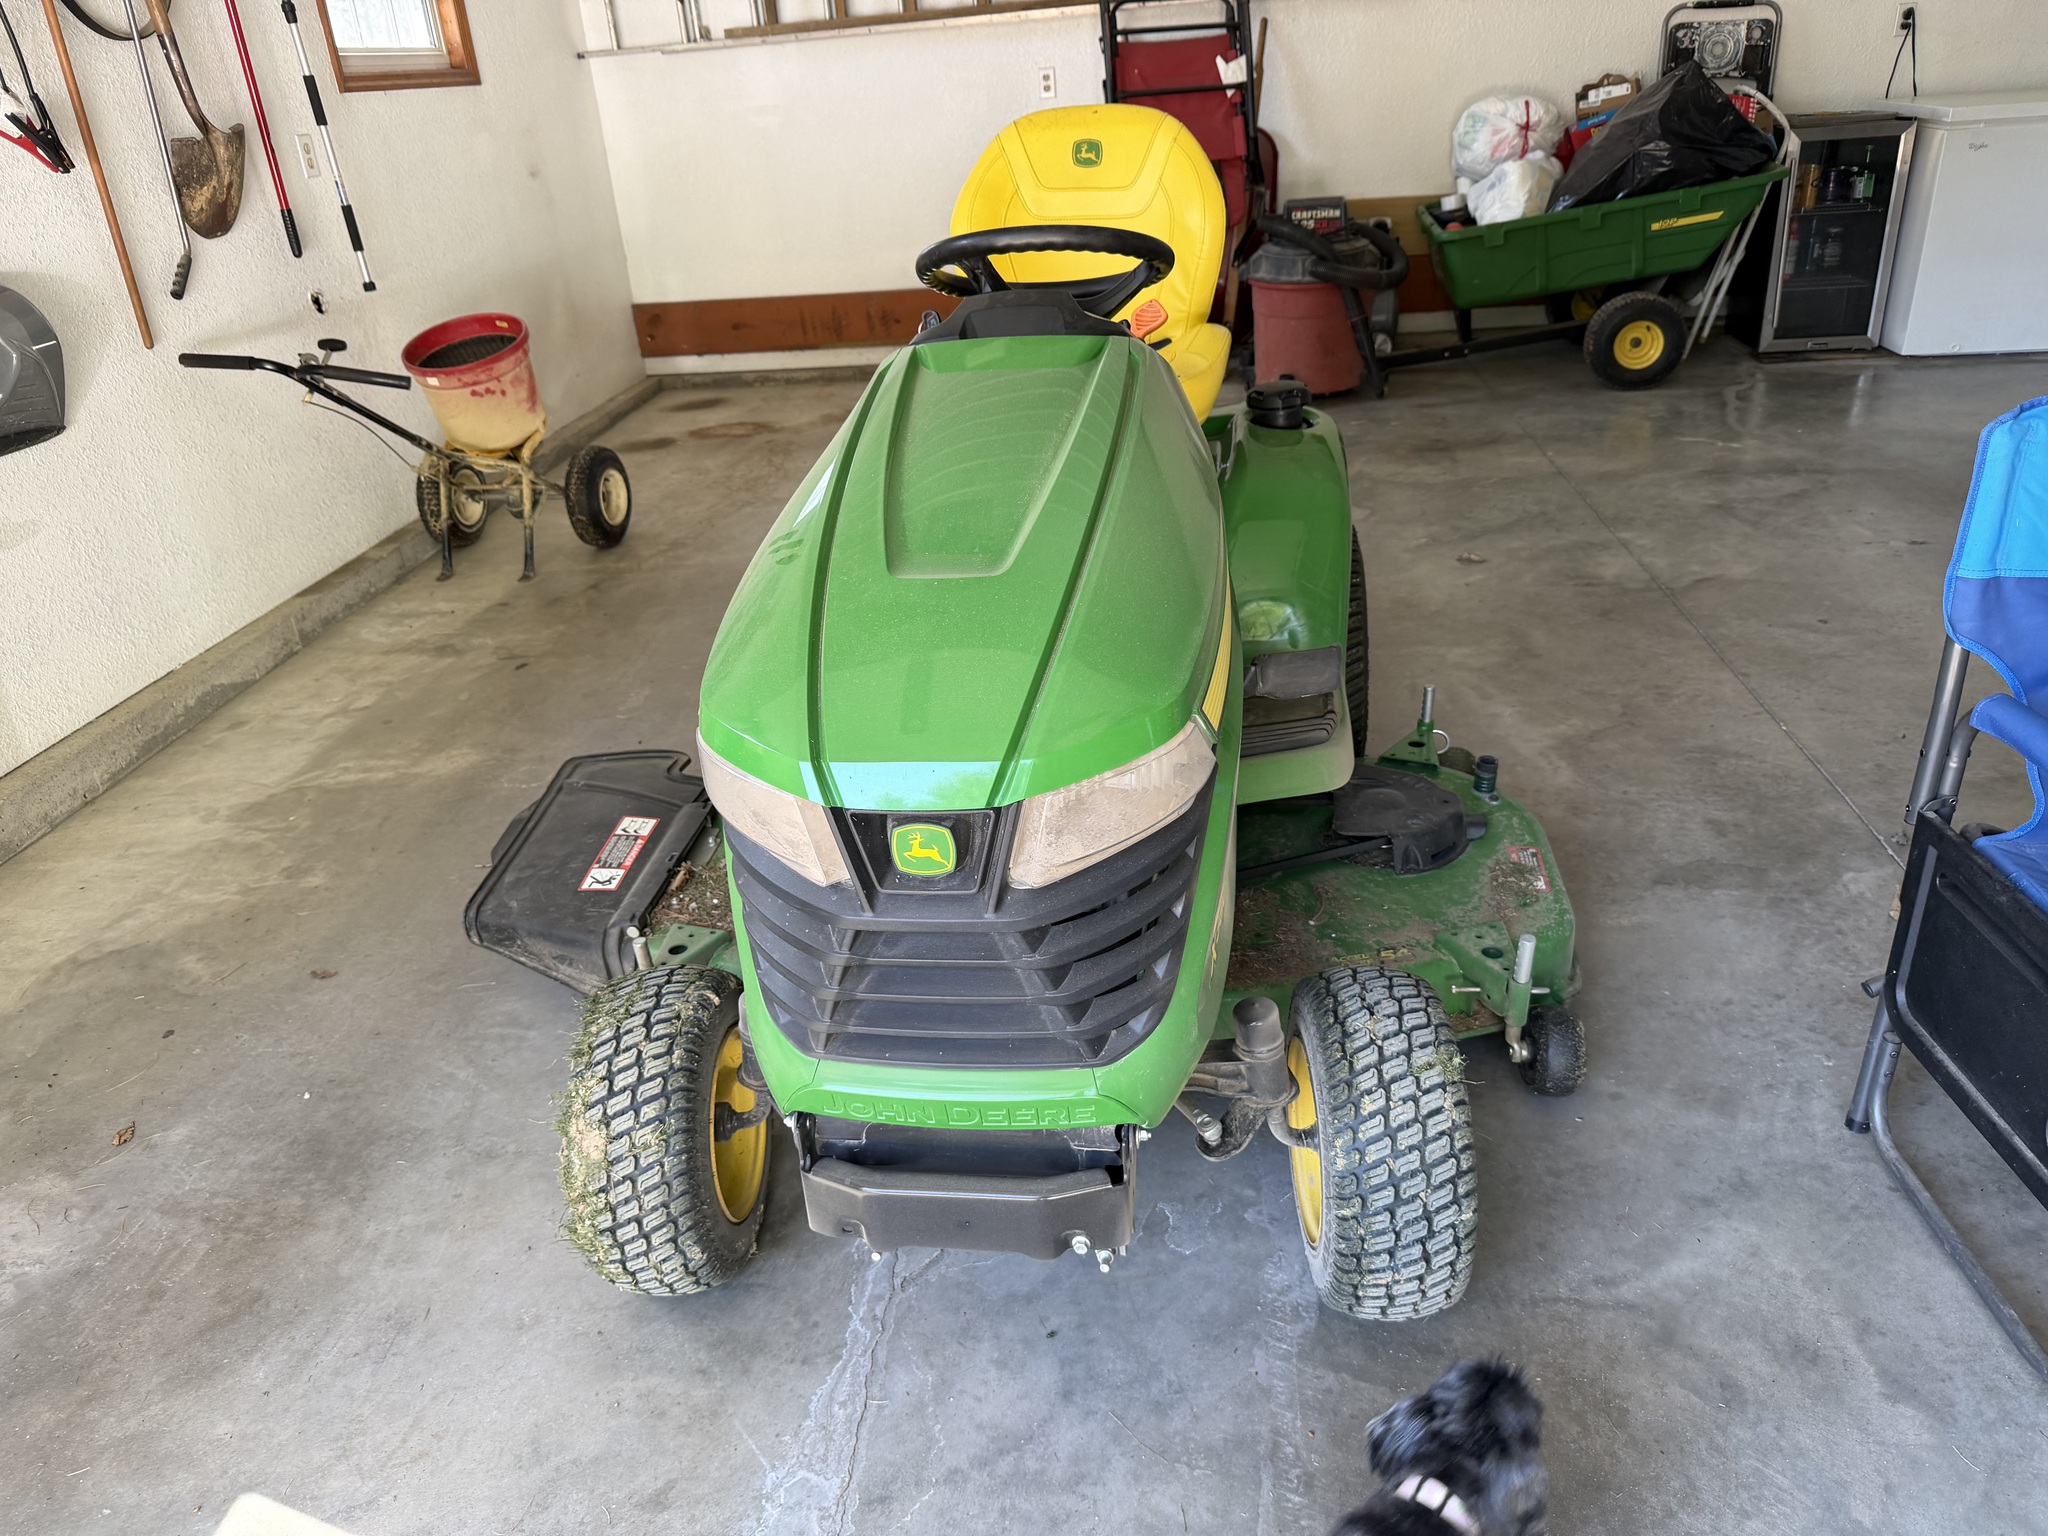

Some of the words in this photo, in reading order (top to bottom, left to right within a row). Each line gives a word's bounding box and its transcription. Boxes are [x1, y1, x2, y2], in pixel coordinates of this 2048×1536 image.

[1291, 208, 1341, 220] CRAFTSMAN
[822, 1093, 936, 1124] JOHN
[945, 1102, 1097, 1127] DEERE
